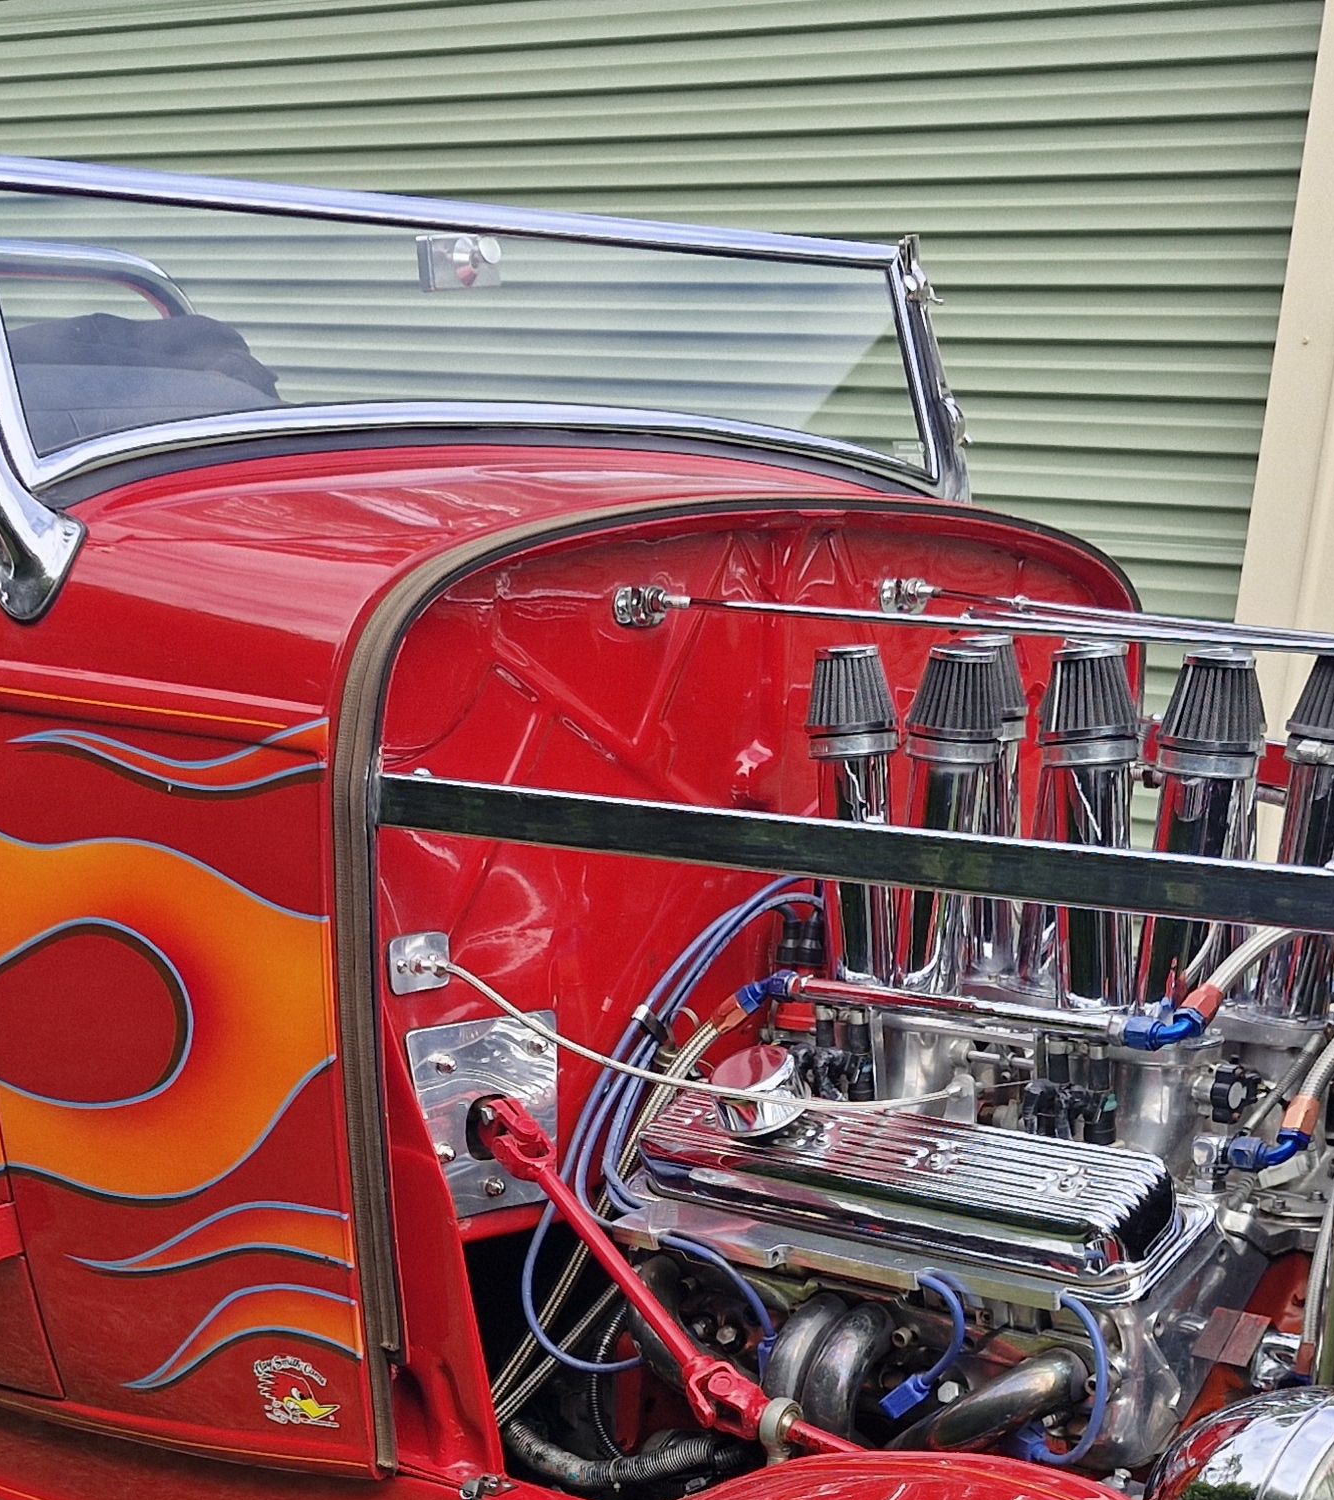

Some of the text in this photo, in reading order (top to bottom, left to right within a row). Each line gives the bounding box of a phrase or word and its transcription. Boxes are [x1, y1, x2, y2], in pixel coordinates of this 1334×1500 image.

[255, 1356, 325, 1385] Clay Smith Cams
